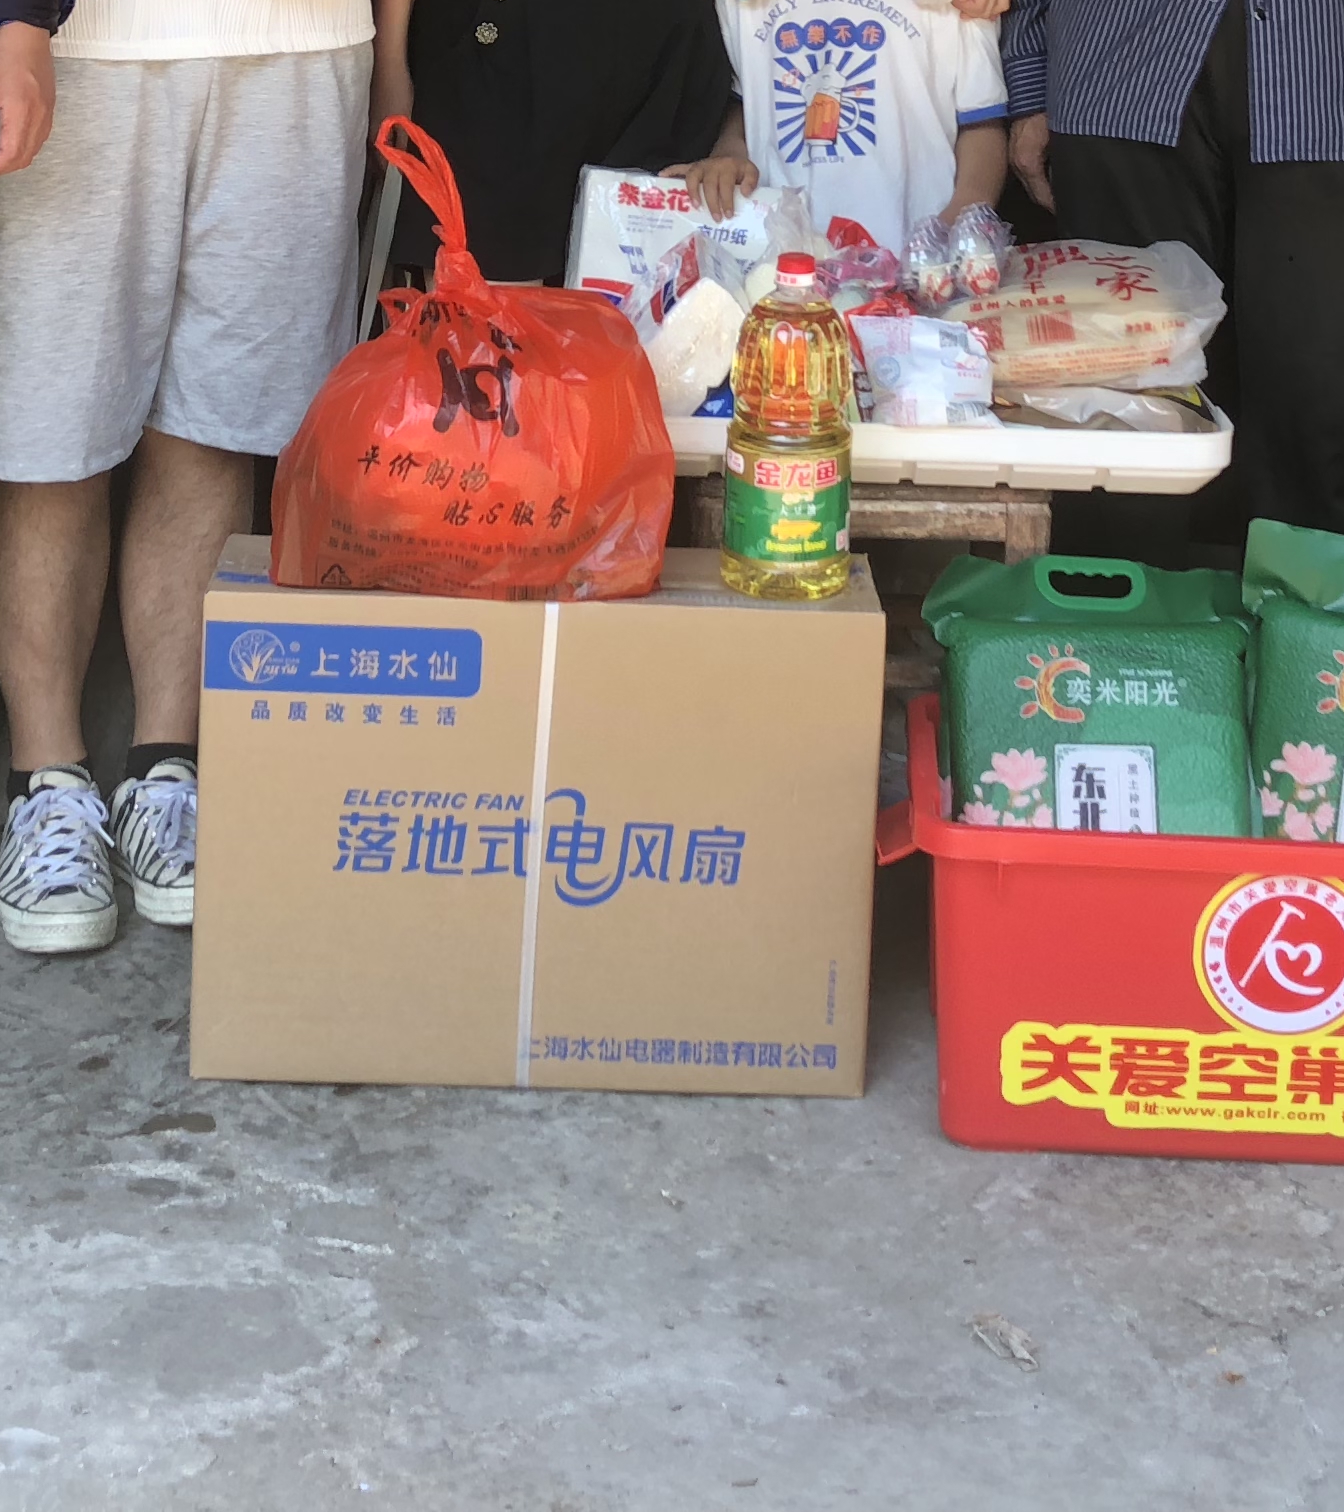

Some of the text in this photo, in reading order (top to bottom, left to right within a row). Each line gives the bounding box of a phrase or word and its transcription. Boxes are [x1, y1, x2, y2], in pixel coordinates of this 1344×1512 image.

[358, 444, 490, 491] 平价购物
[755, 459, 837, 488] 金龙鱼
[441, 495, 572, 528] 贴心服务
[310, 647, 457, 681] 上海水仙
[1066, 677, 1180, 706] 奕米阳光
[251, 700, 456, 727] 品质改变生活
[343, 789, 525, 811] ELECTRIC FAN
[333, 791, 746, 905] 落地式电风扇
